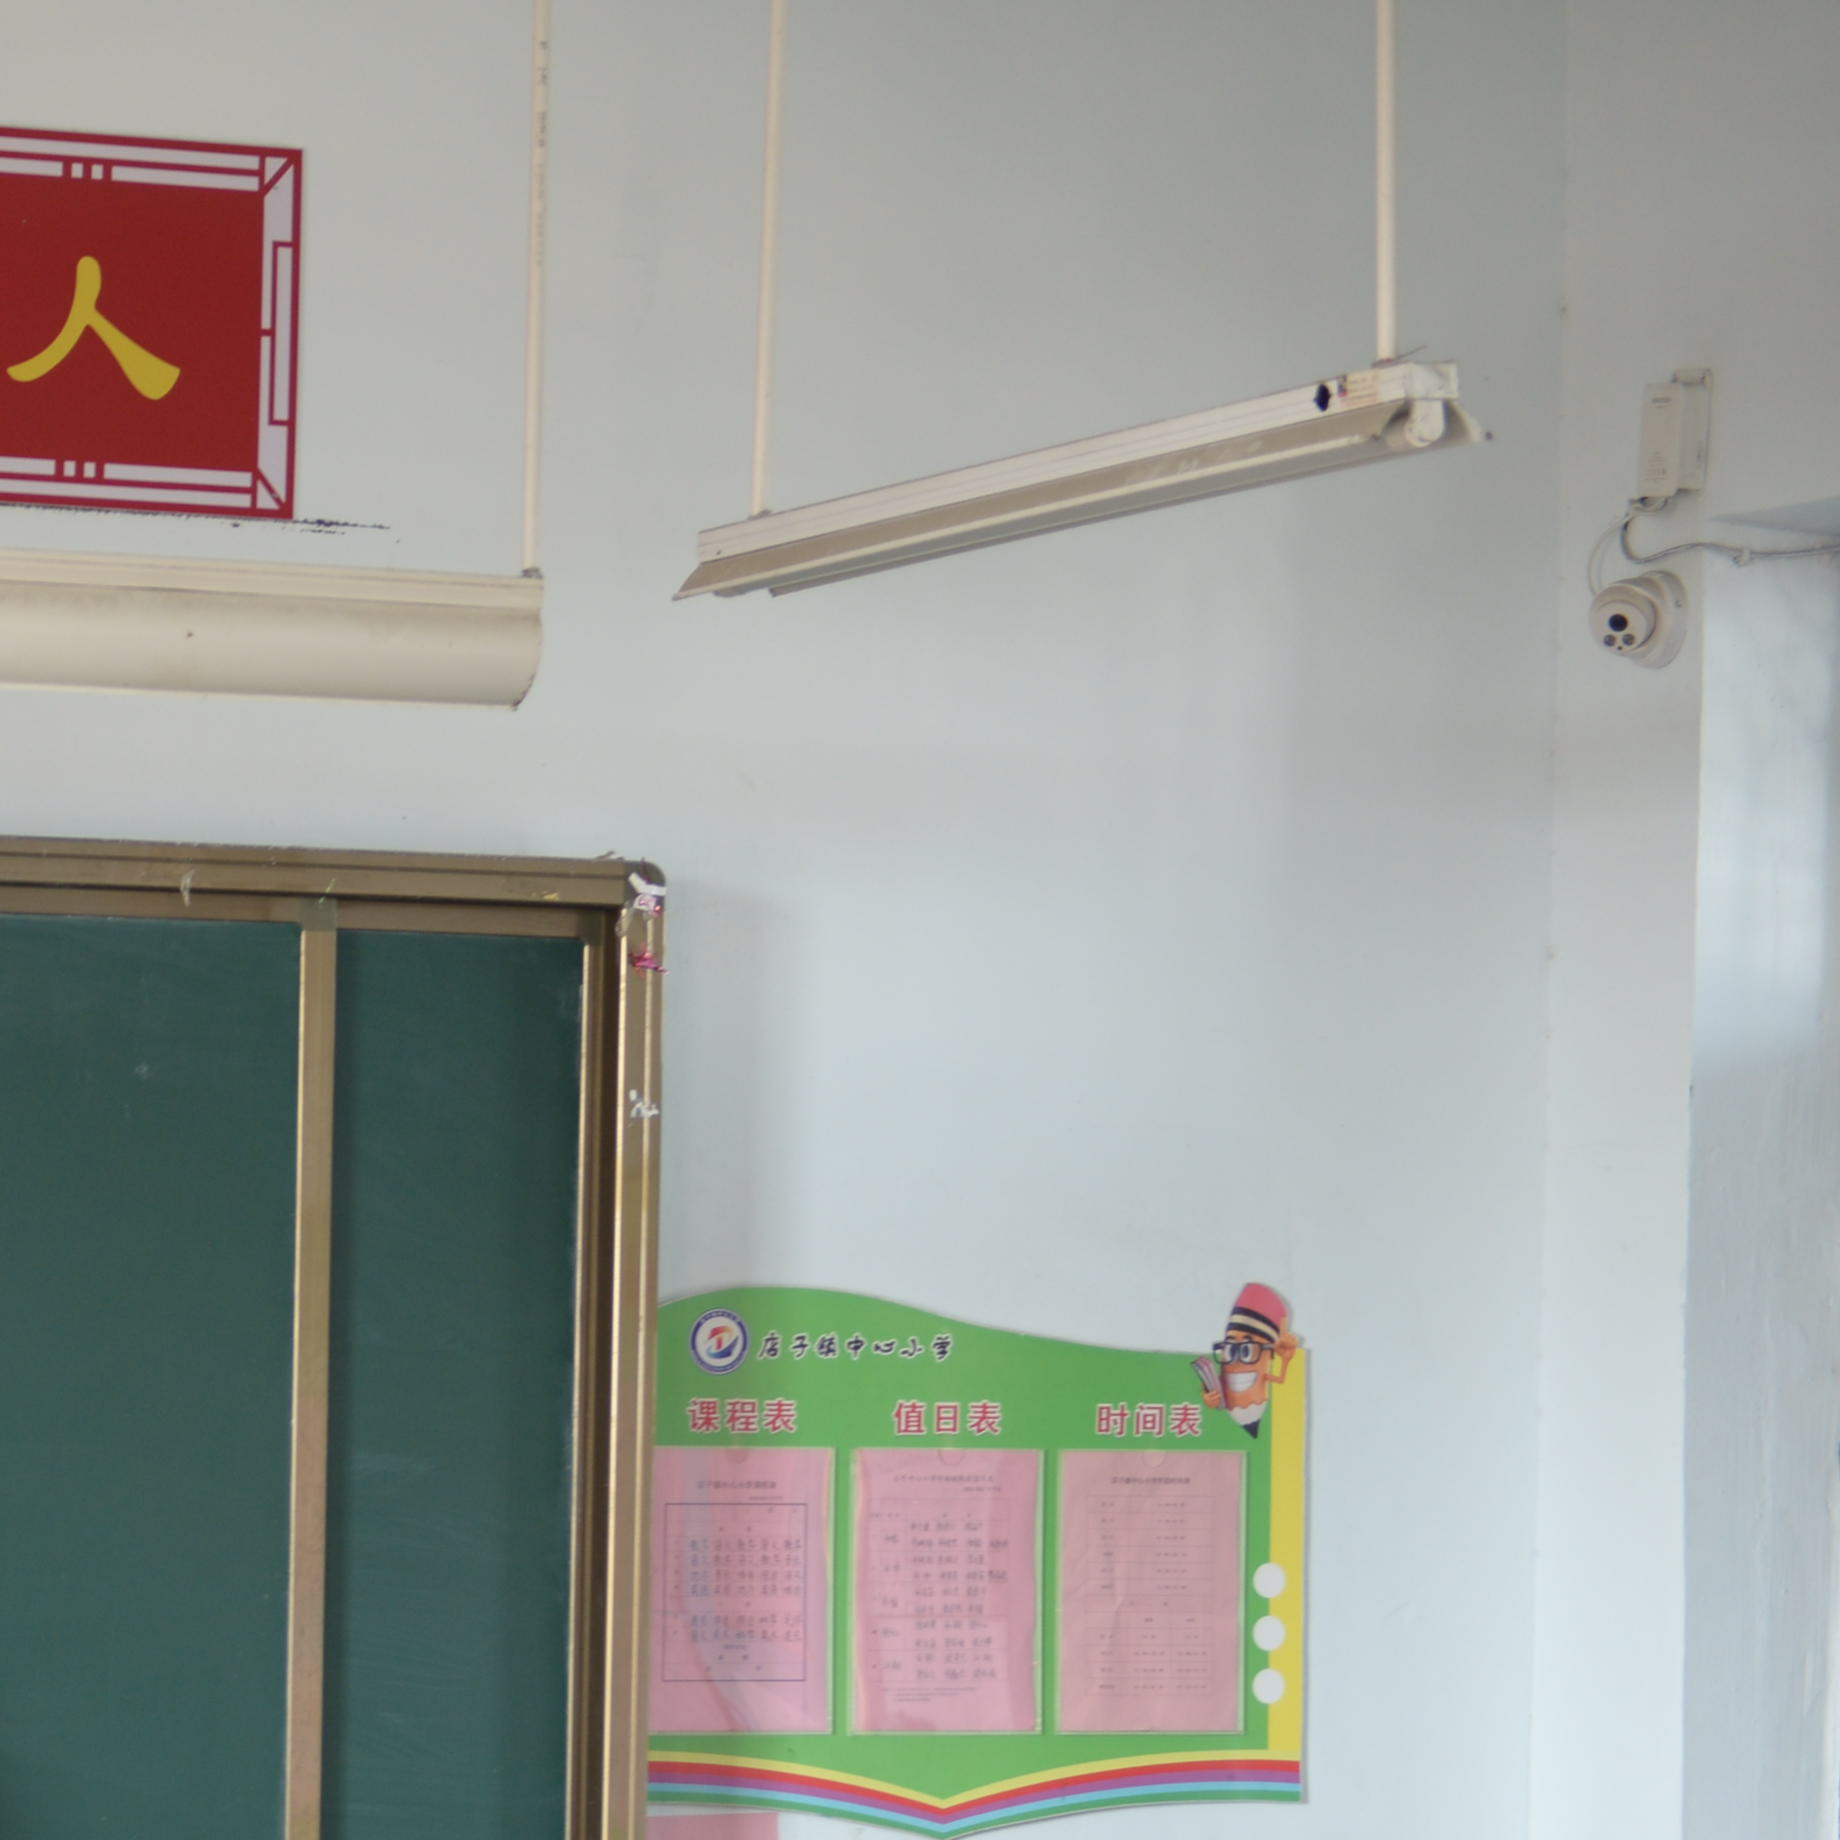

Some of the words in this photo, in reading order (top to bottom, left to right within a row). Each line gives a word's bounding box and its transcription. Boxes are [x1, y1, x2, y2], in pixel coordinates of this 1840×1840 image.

[759, 1331, 952, 1360] 店子镇中心小学
[688, 1399, 798, 1434] 课程表
[892, 1400, 1002, 1436] 值日表
[1095, 1402, 1203, 1437] 时间表
